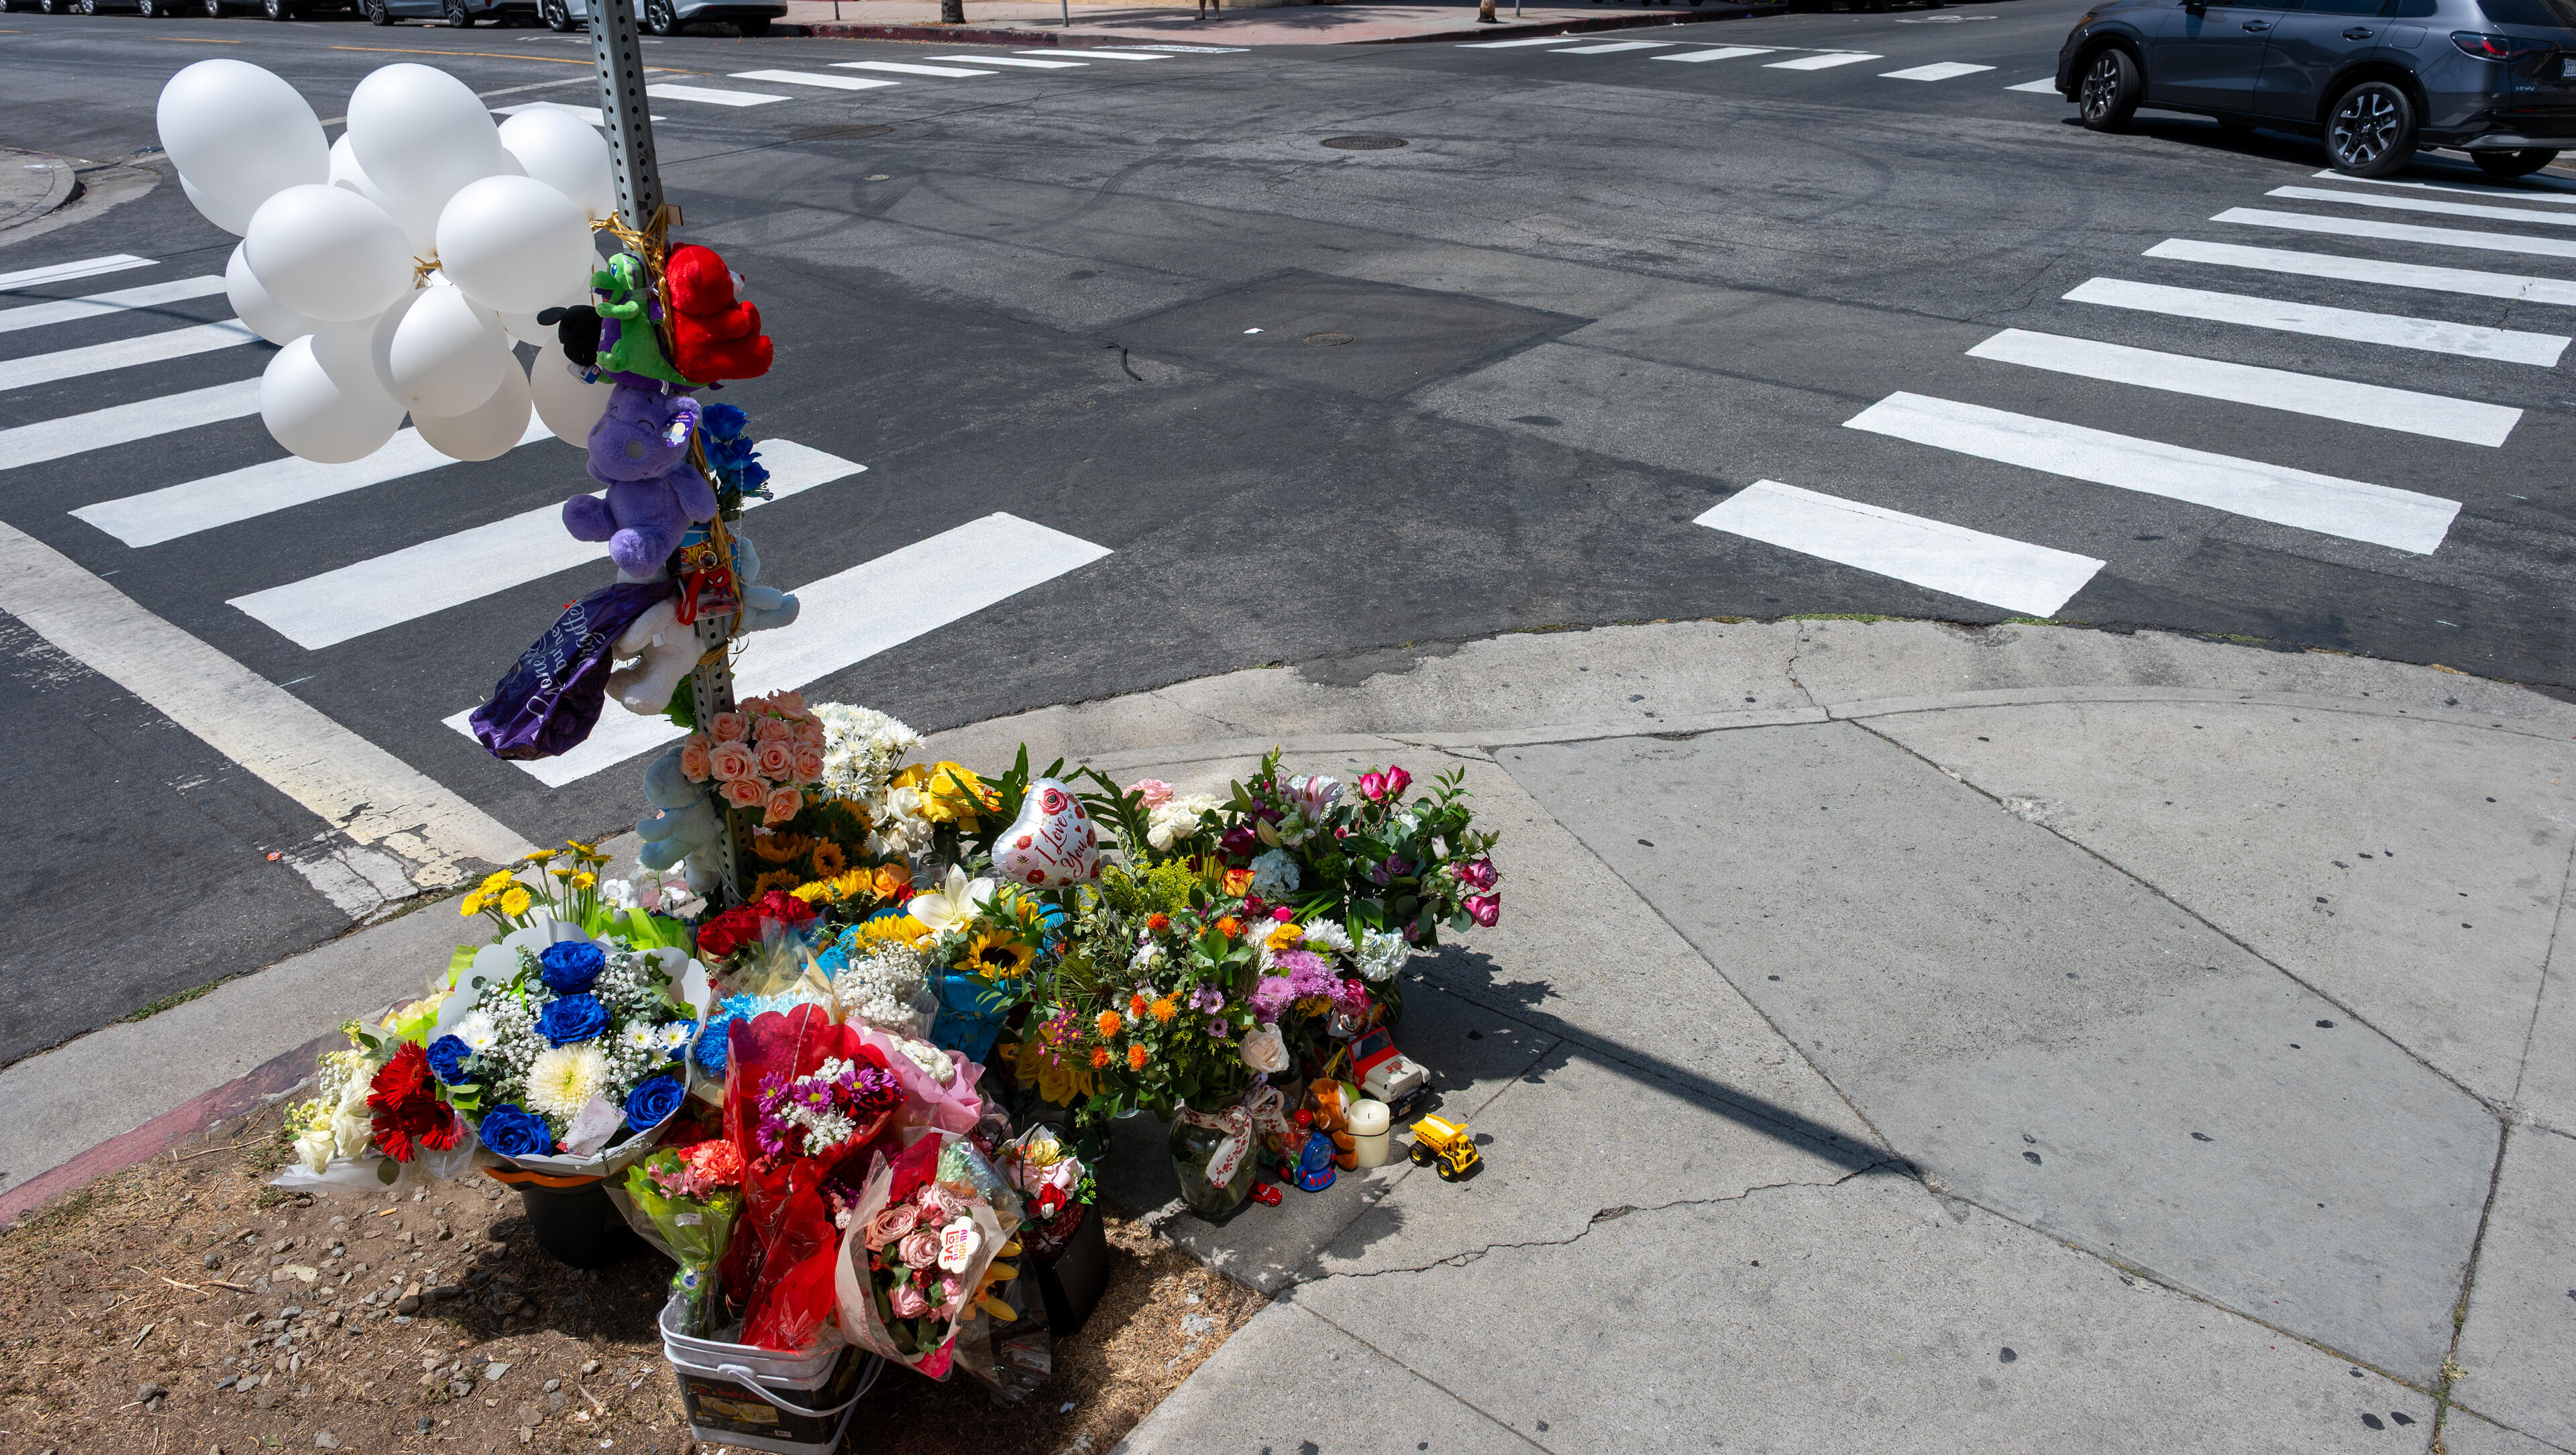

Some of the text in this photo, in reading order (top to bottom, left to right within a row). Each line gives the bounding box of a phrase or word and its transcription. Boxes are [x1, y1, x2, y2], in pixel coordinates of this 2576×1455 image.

[1034, 814, 1068, 867] I Love
[1060, 837, 1087, 878] You
[944, 1230, 960, 1262] LOVE
[960, 1229, 968, 1242] ALL
[953, 1253, 959, 1261] IS
